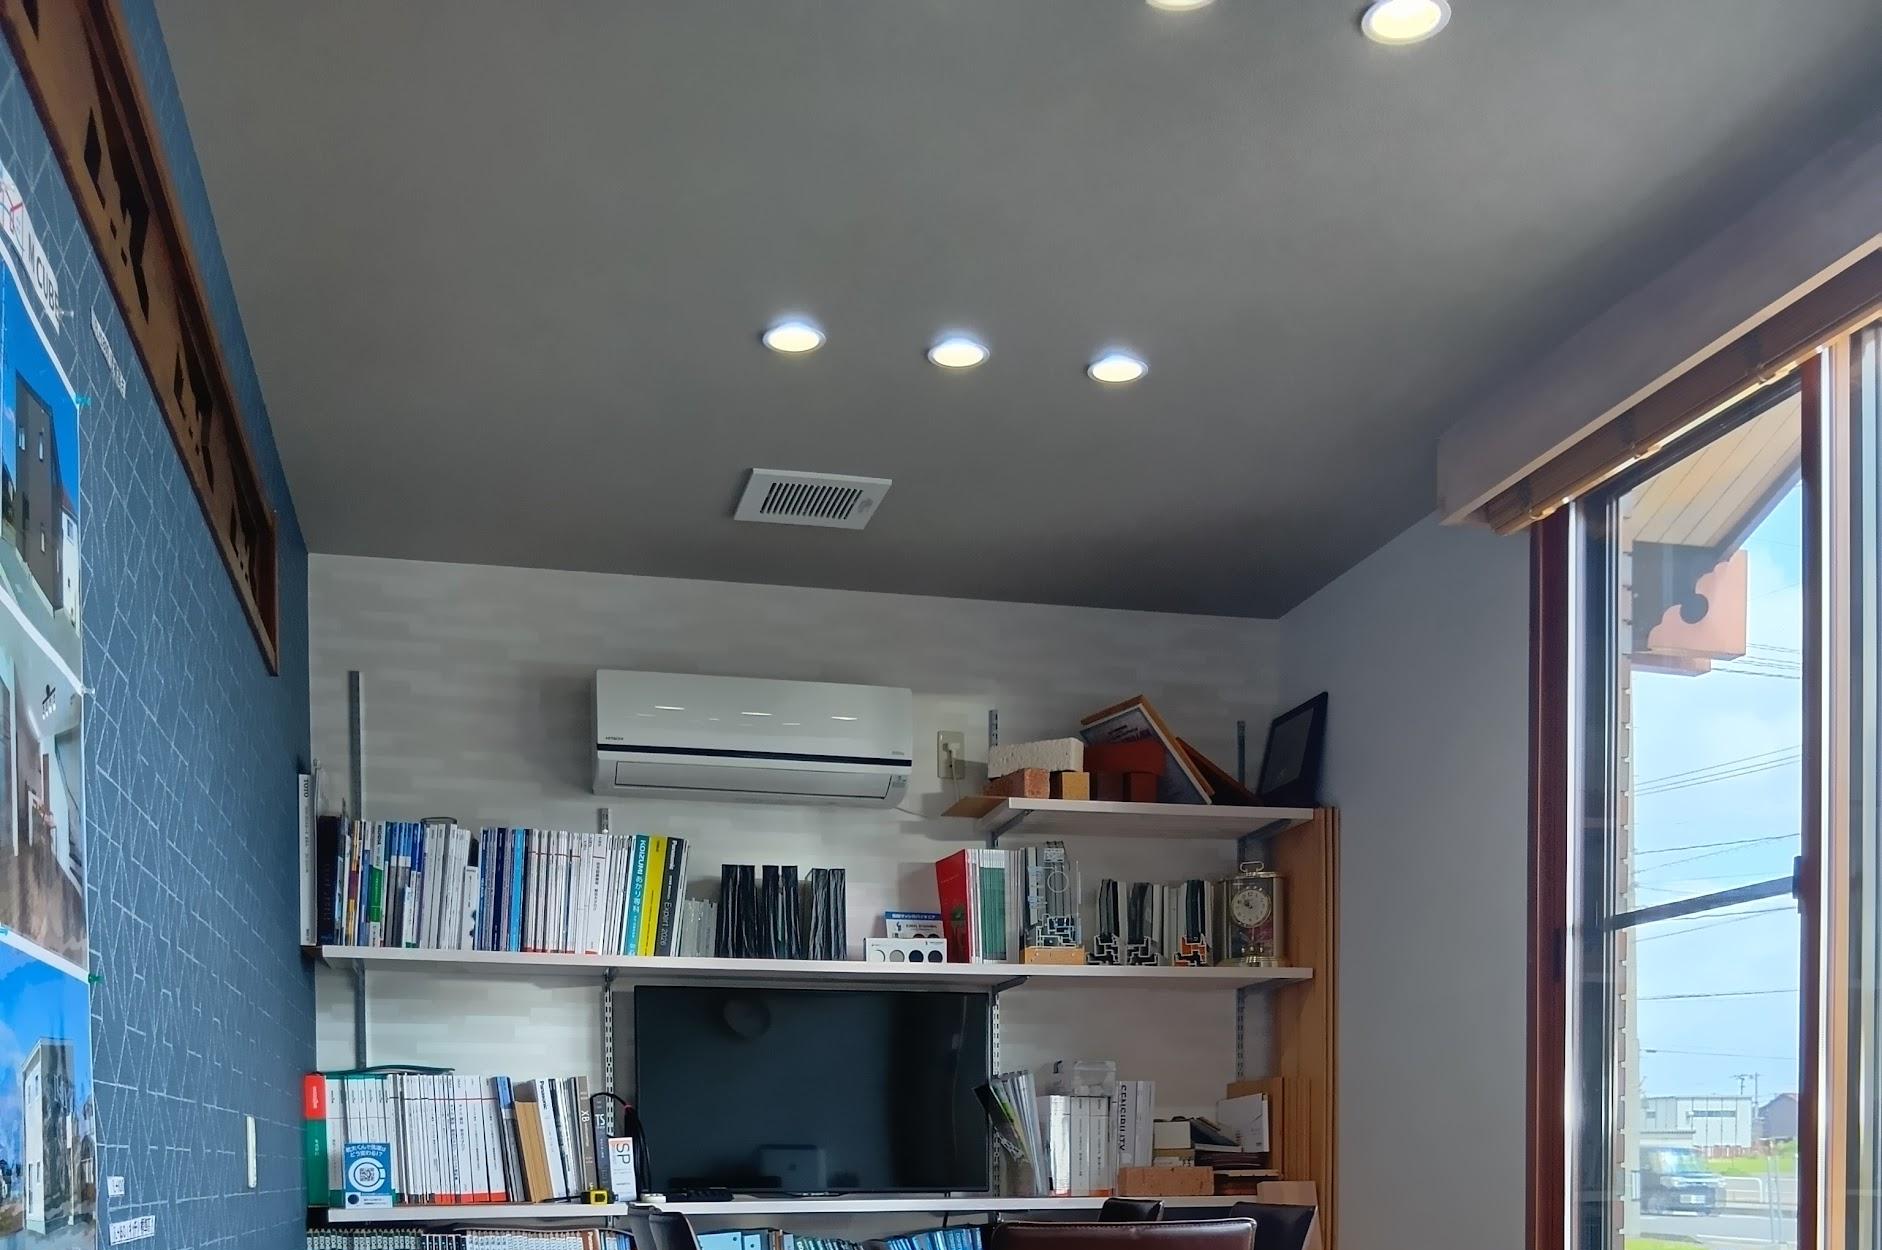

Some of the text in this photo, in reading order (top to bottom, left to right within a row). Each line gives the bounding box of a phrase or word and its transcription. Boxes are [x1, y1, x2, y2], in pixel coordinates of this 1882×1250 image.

[637, 839, 647, 874] KOIZUMI
[669, 840, 678, 870] Panasonic
[663, 901, 672, 926] Expert
[539, 1080, 548, 1110] Panasonic
[581, 1110, 590, 1122] XB
[595, 1113, 606, 1125] TS
[616, 1143, 631, 1165] SP
